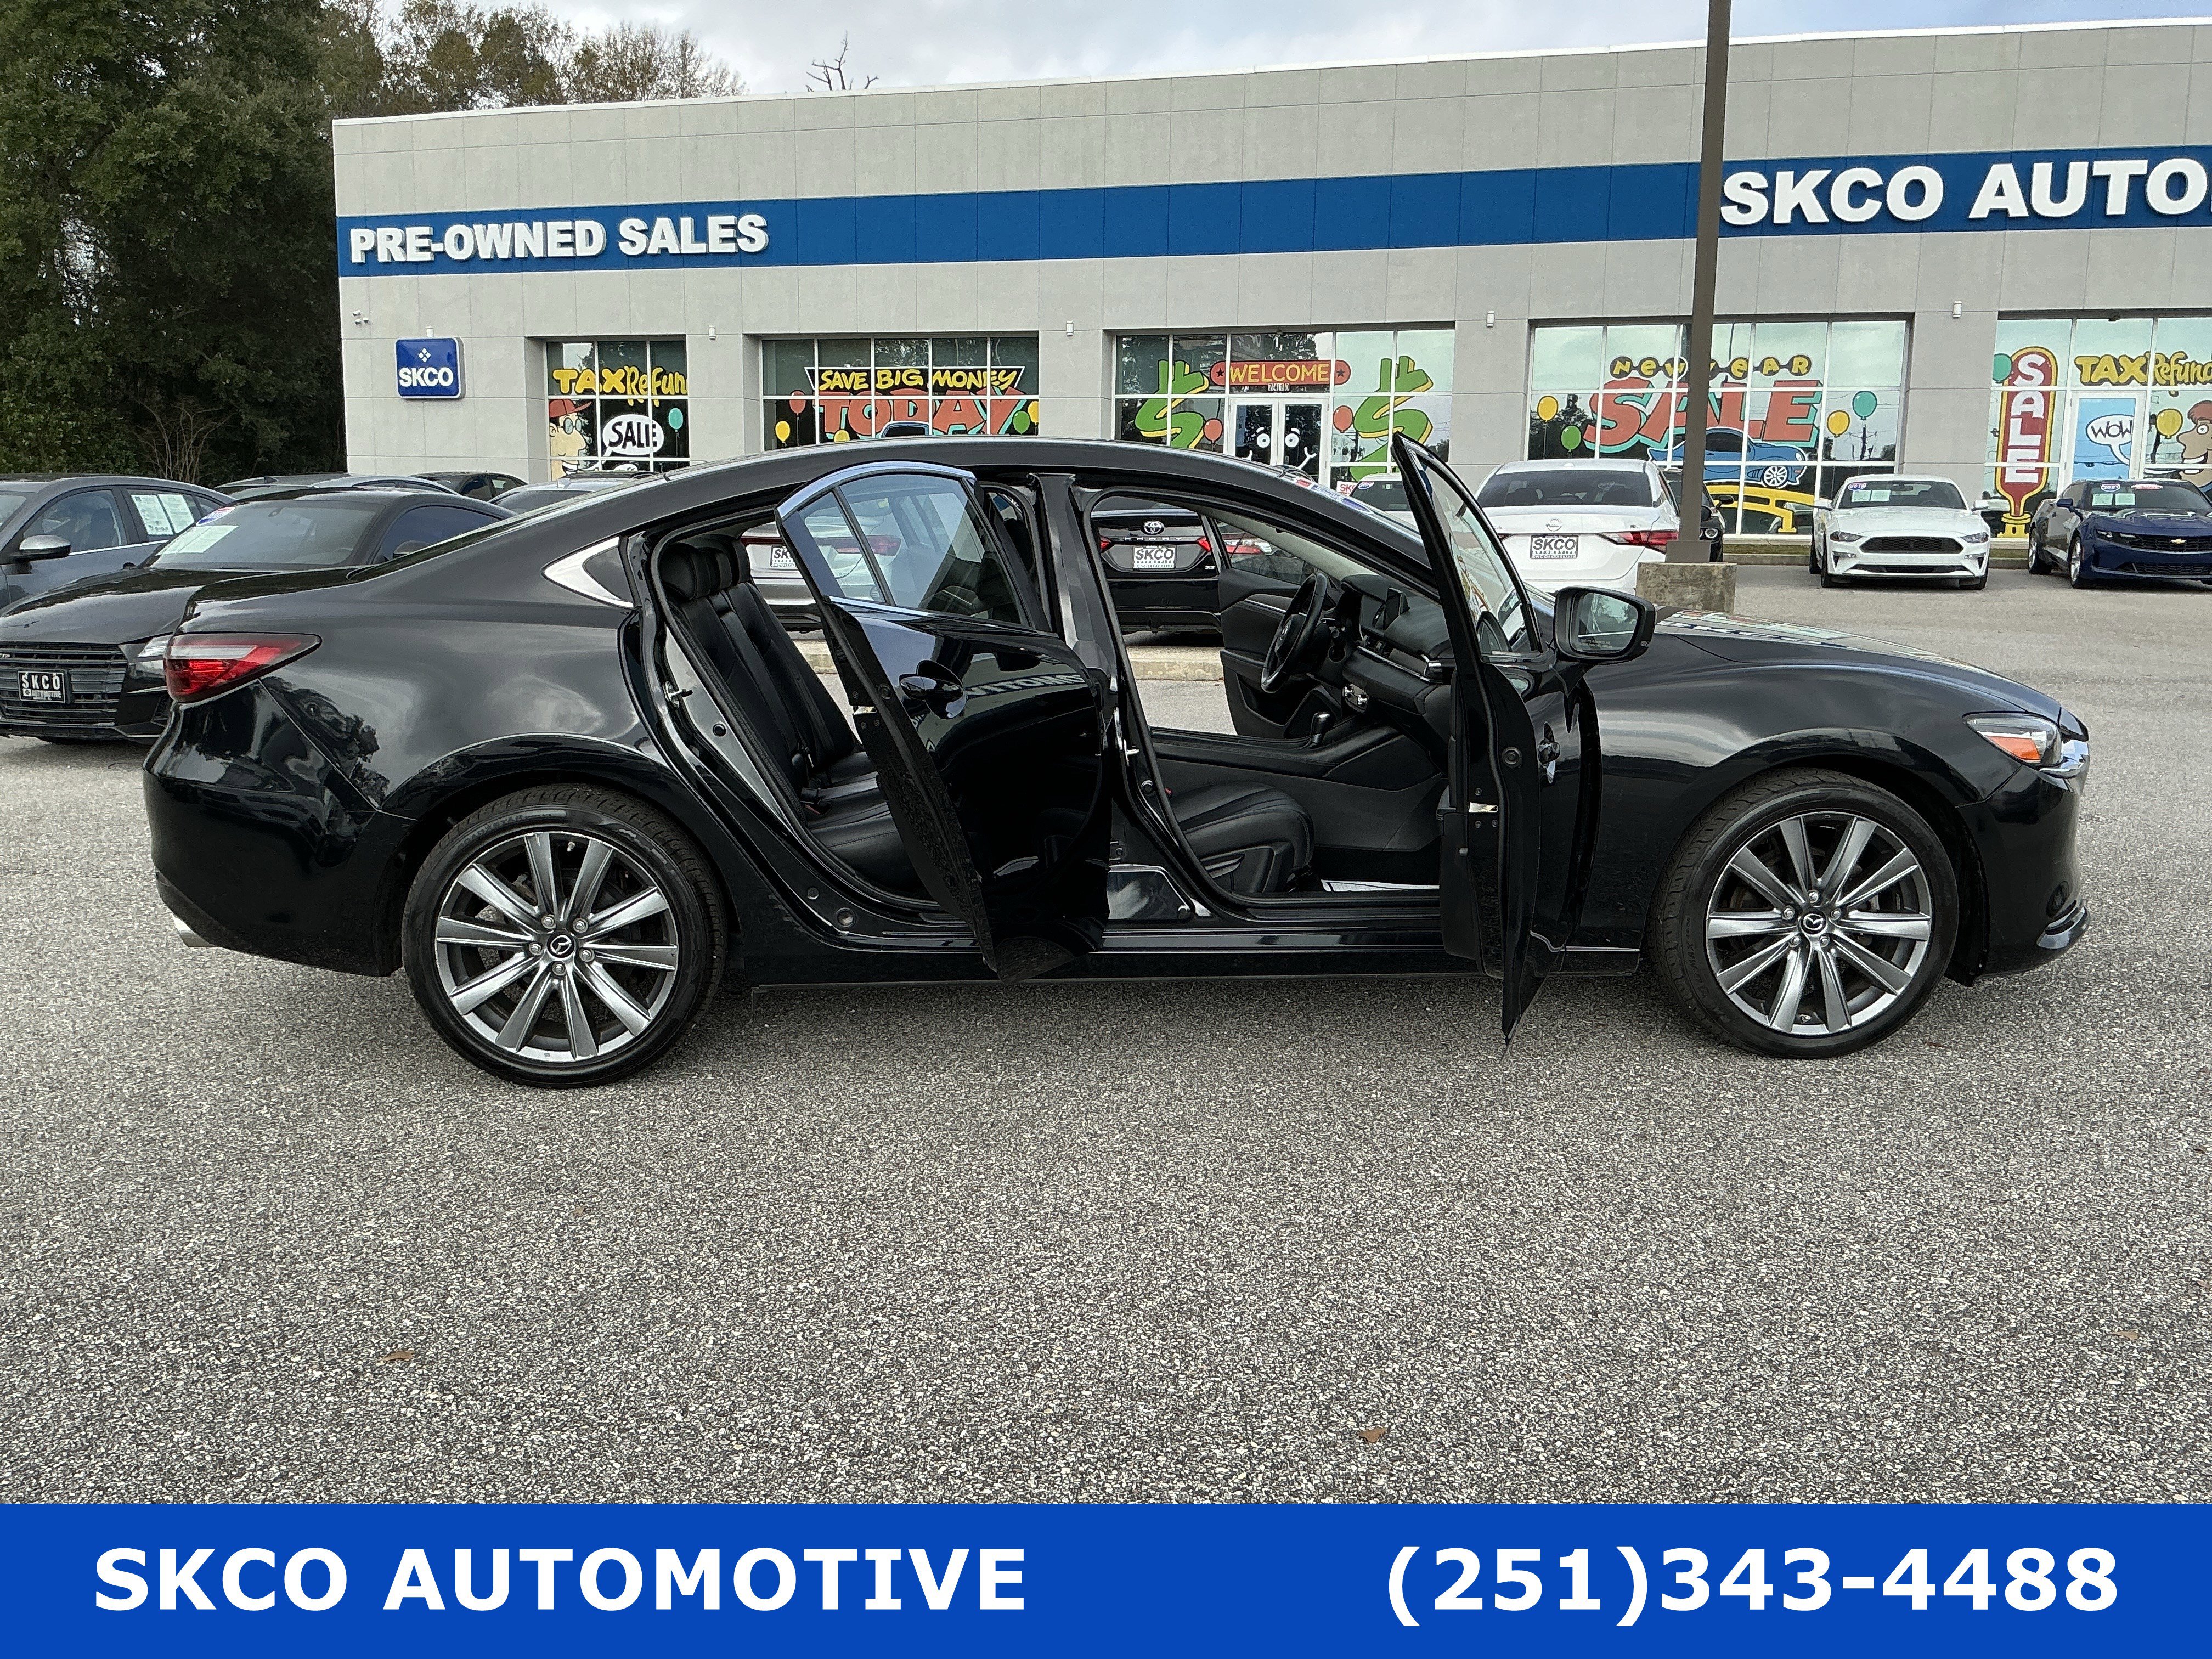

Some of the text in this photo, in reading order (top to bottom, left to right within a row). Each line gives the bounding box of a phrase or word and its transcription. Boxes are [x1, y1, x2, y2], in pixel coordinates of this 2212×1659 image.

[1720, 157, 2212, 227] SKCO AUTO
[350, 214, 769, 264] PRE-OWNED SALES
[399, 367, 454, 388] SKCO
[1229, 363, 1330, 383] WELCOME
[1709, 357, 1809, 377] eAR
[2074, 354, 2149, 385] TAX
[552, 368, 626, 394] TAX
[819, 369, 1018, 391] SAVE BIG MONEY
[816, 386, 1026, 436] TODAY
[1583, 377, 1822, 450] SALE
[2004, 354, 2046, 483] SALE
[608, 421, 657, 449] SALE
[2091, 421, 2132, 438] WOW
[1340, 483, 1356, 492] SK
[773, 549, 790, 559] SK
[1135, 549, 1174, 560] SKCO
[1533, 539, 1576, 550] SKCO
[22, 674, 60, 690] SKCO
